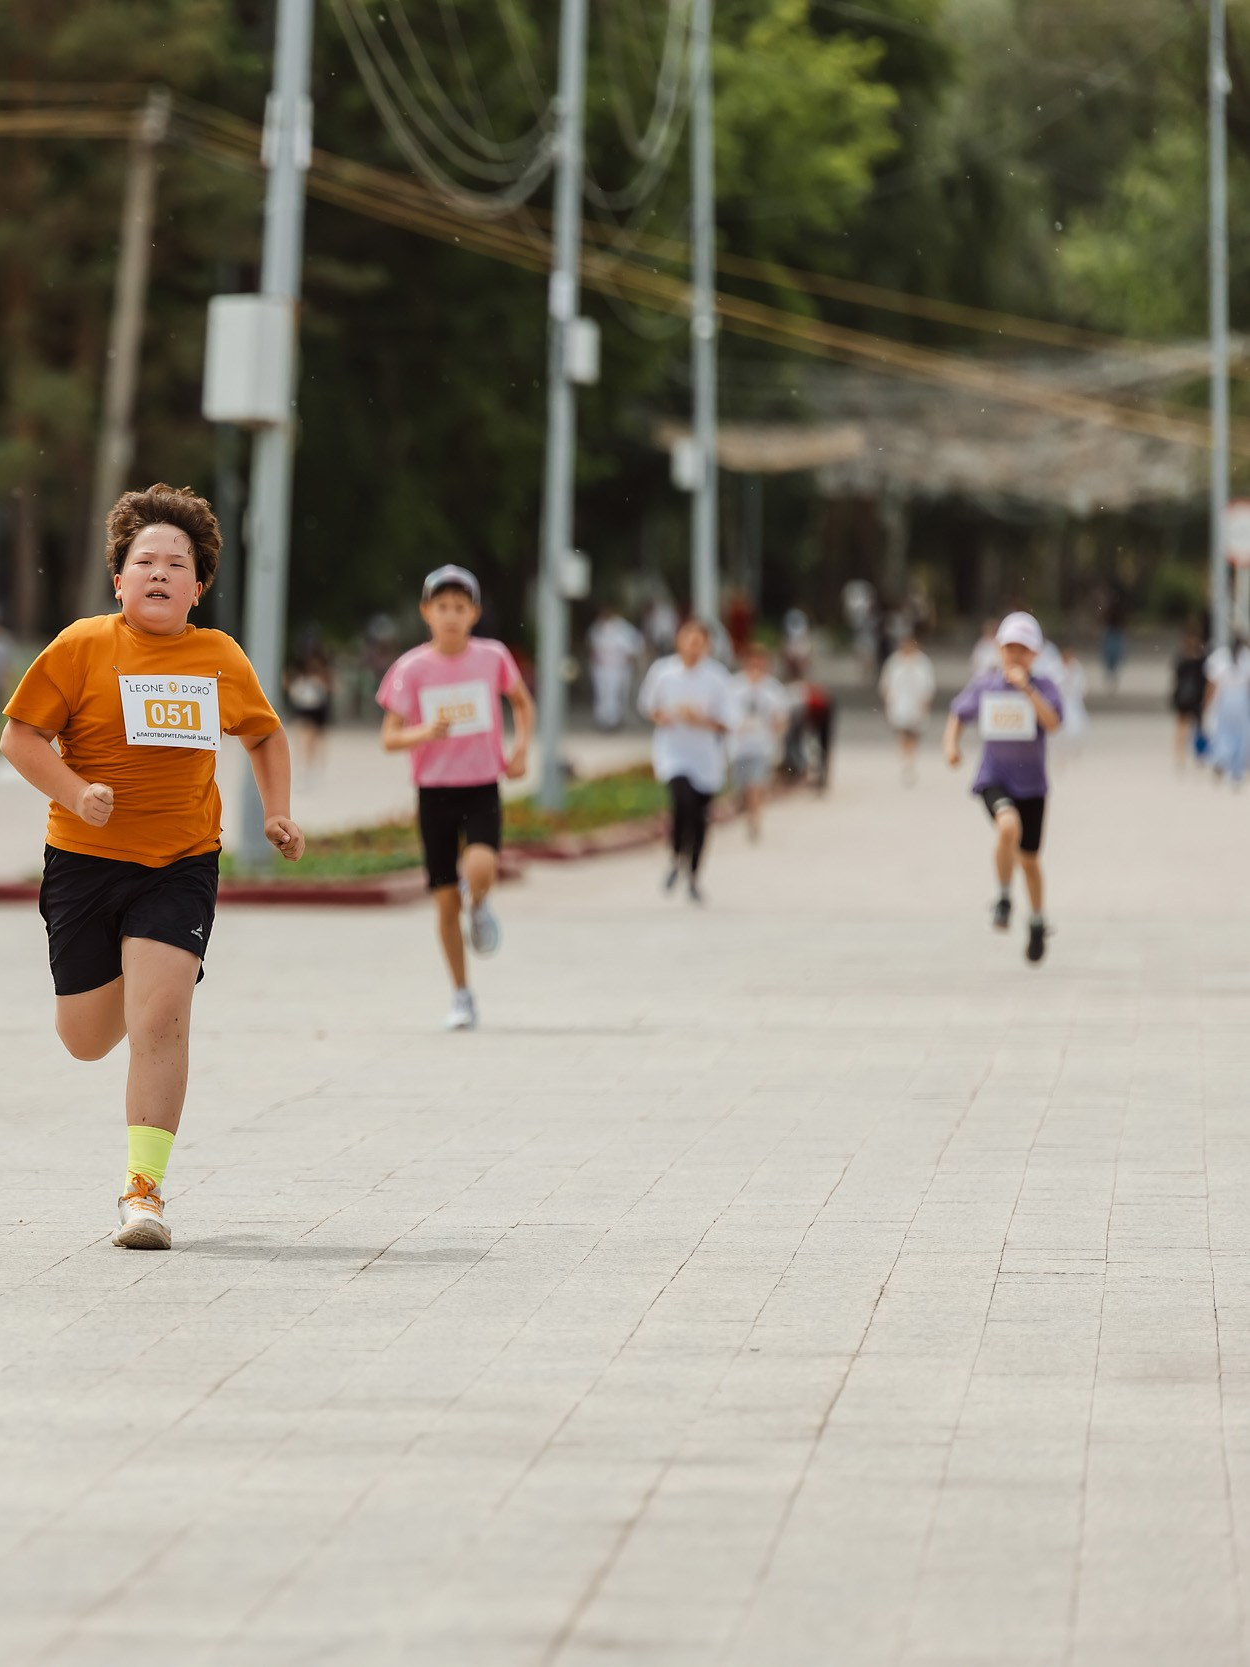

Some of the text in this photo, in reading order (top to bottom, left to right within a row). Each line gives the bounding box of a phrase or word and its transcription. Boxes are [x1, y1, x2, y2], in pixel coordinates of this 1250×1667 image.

[129, 684, 164, 693] LEONE
[151, 703, 193, 726] 051
[136, 731, 197, 740] БЛАГОТВОРИТЕЛЬНЫЙ
